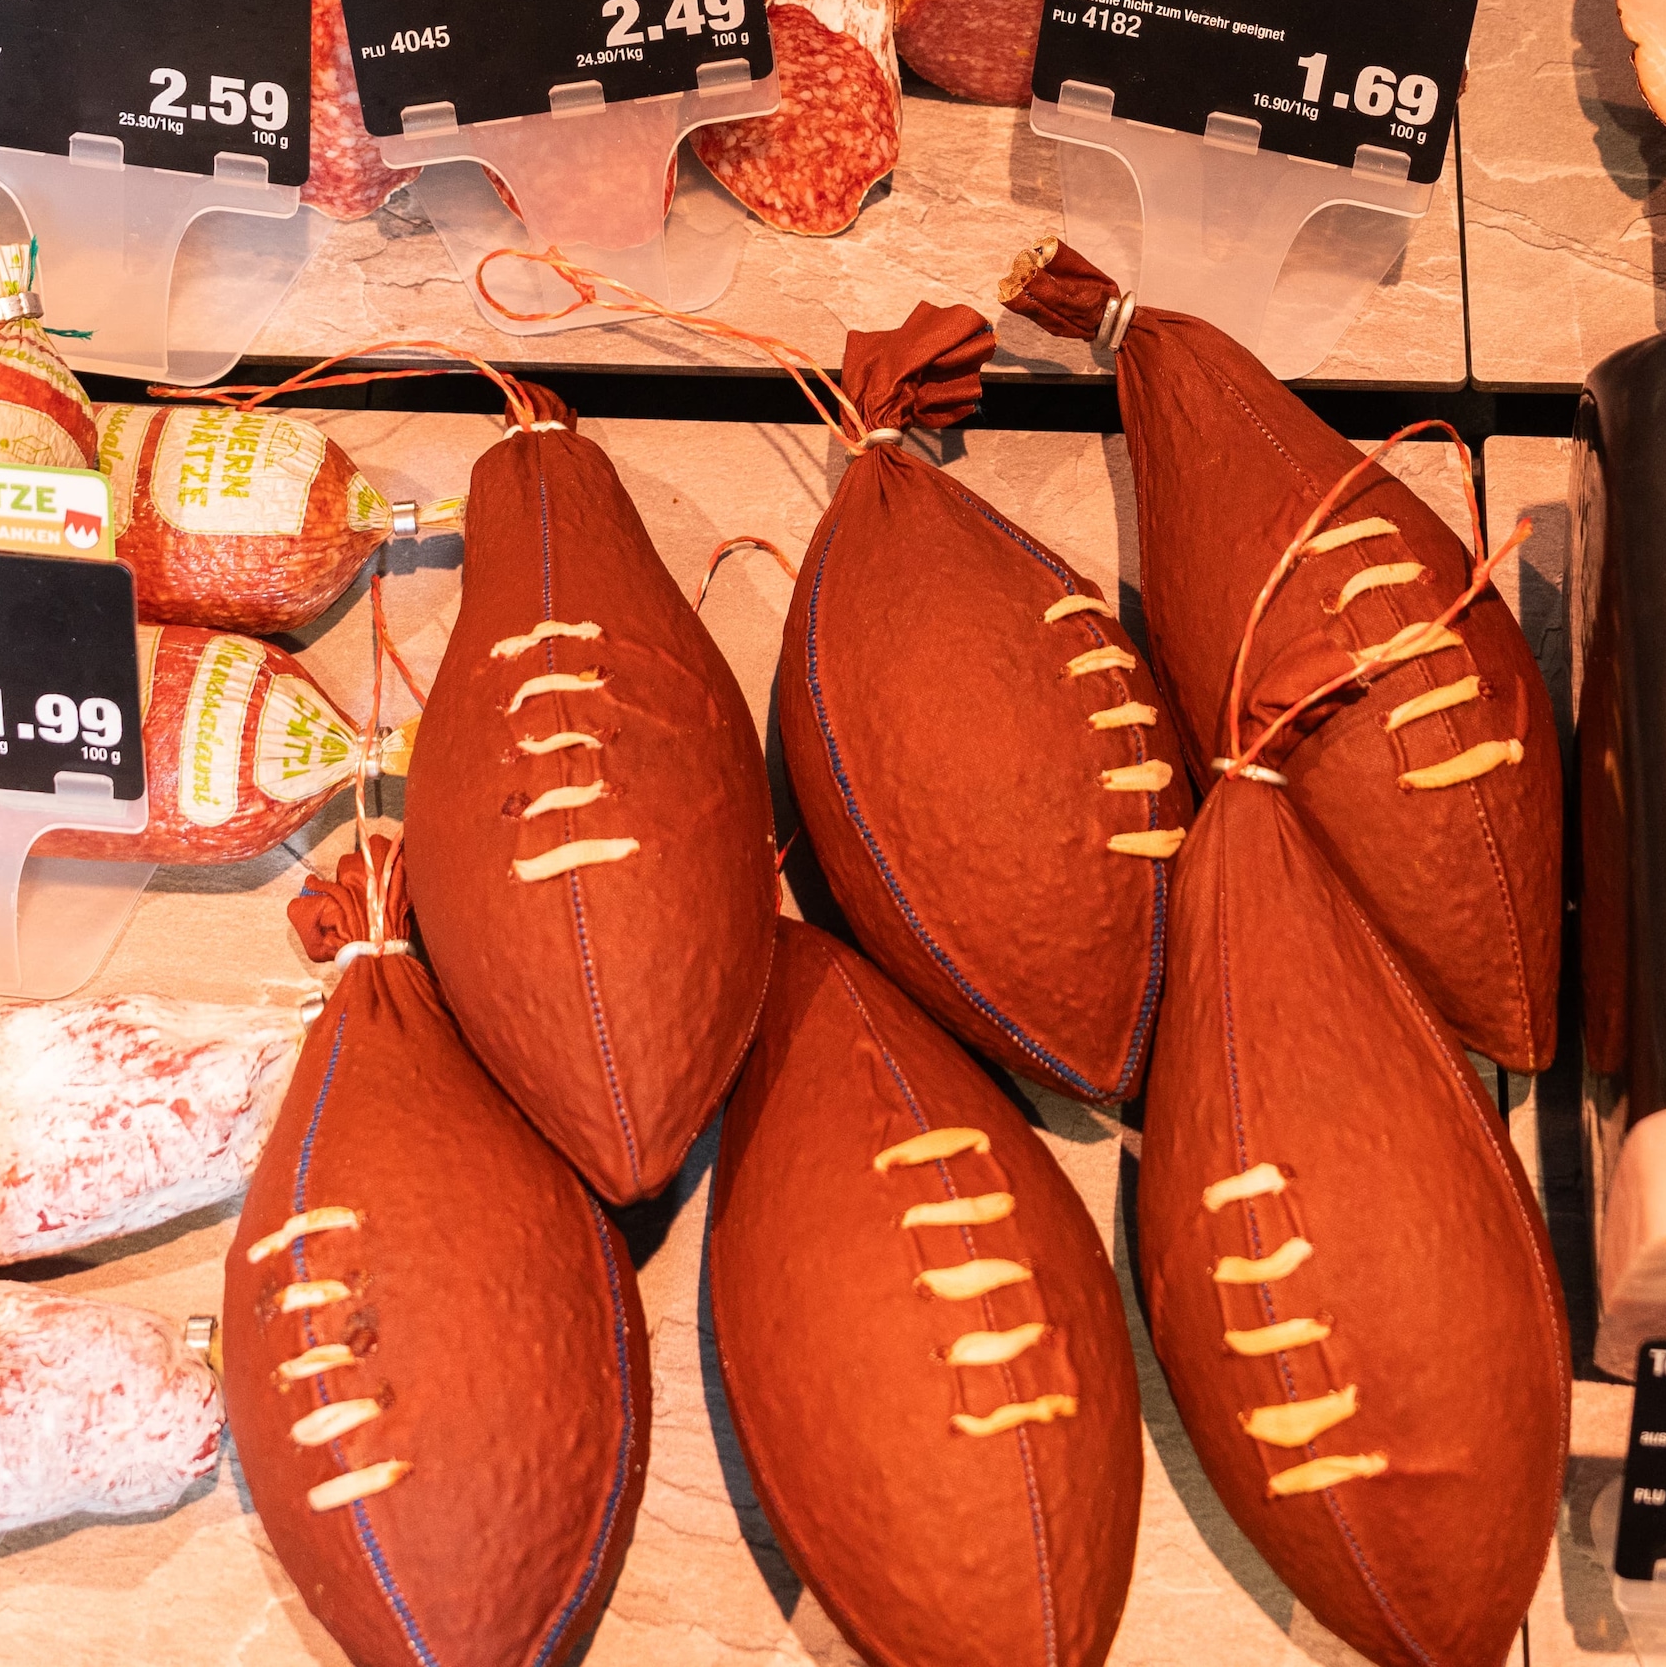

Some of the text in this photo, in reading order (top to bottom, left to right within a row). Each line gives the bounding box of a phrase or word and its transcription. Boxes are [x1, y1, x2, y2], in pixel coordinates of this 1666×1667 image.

[1052, 6, 1142, 38] PLU 4182
[1155, 4, 1182, 20] zum
[1184, 8, 1231, 30] Verzehr
[1231, 21, 1286, 42] geeignet
[390, 25, 451, 54] 4045
[149, 67, 289, 136] 2.59
[1295, 52, 1439, 126] 1.69
[1253, 92, 1319, 121] 16.90/1kg
[1389, 122, 1427, 145] 100 g
